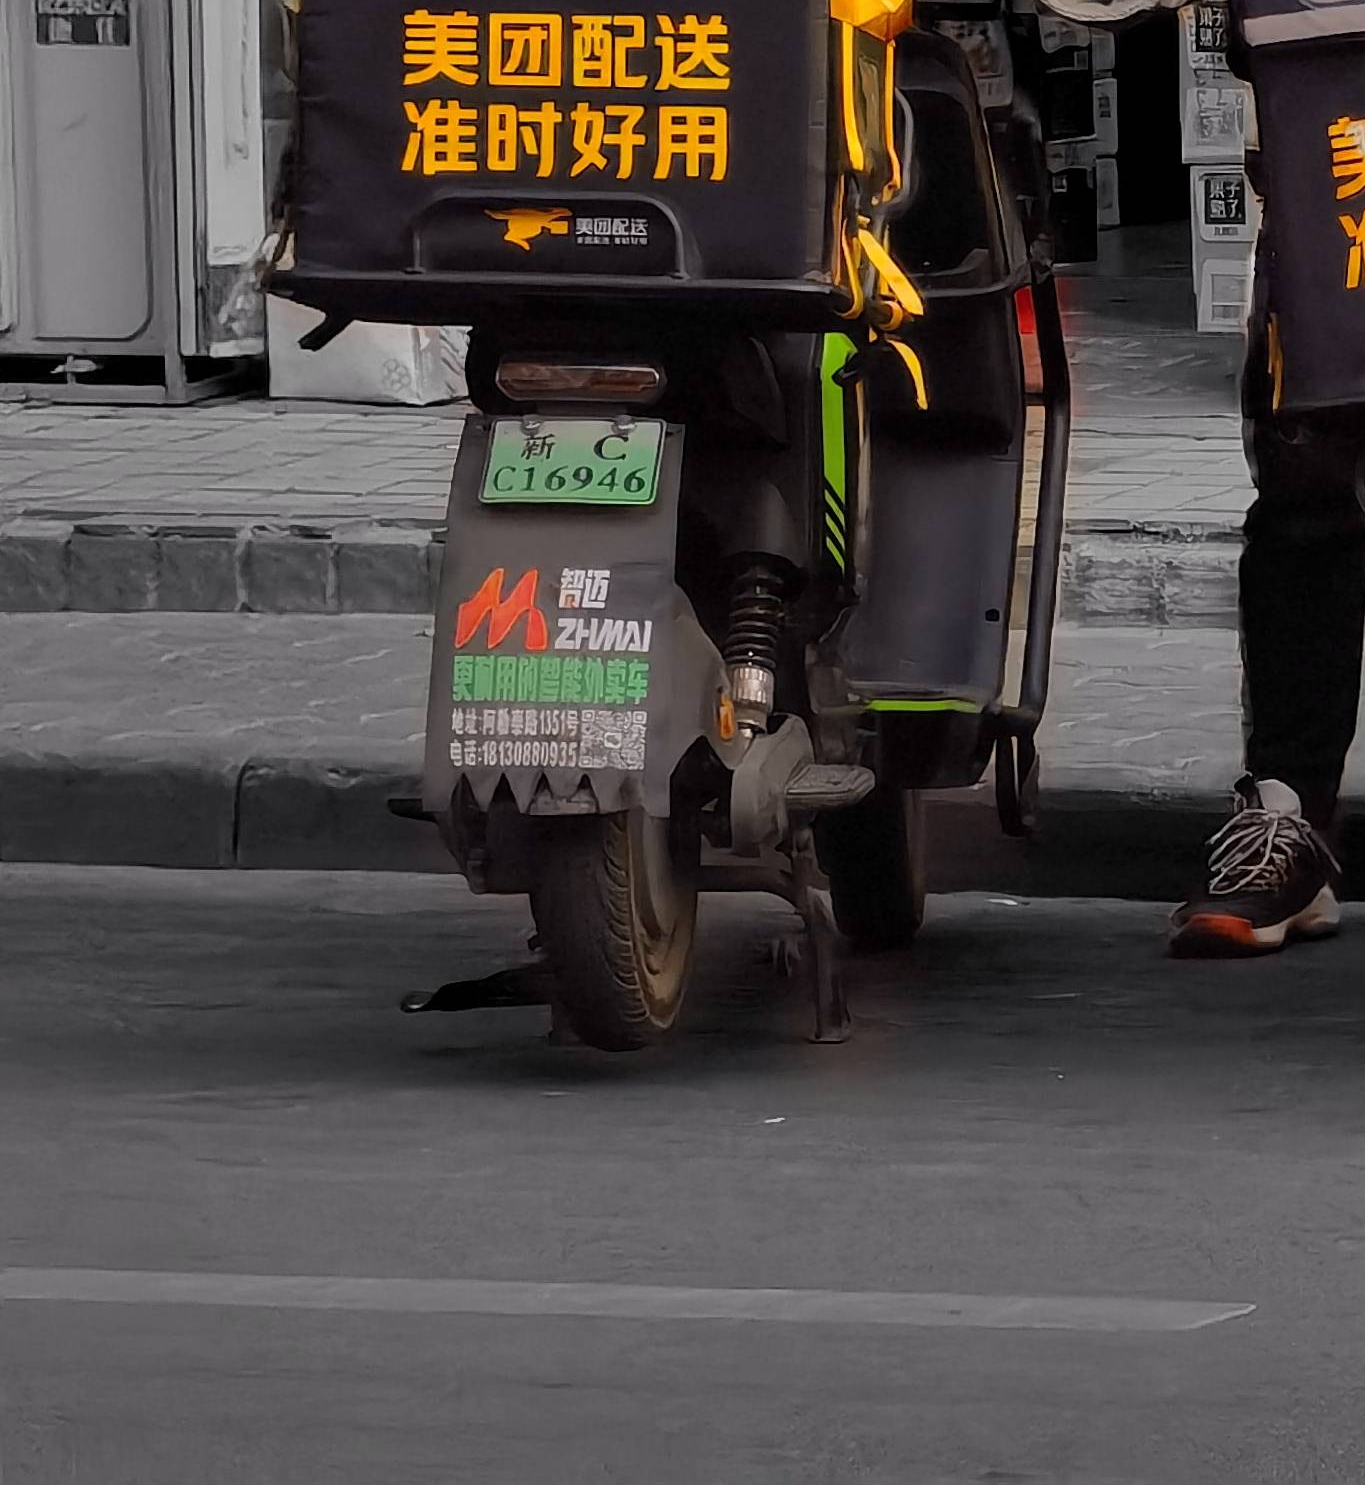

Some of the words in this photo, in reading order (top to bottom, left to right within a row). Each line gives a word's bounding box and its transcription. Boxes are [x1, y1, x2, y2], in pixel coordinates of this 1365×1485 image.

[403, 10, 730, 90] 美团配送
[401, 100, 729, 181] 准时好用
[521, 433, 555, 462] 新
[594, 434, 631, 461] C
[493, 465, 646, 494] C16946
[558, 568, 611, 610] 智迈
